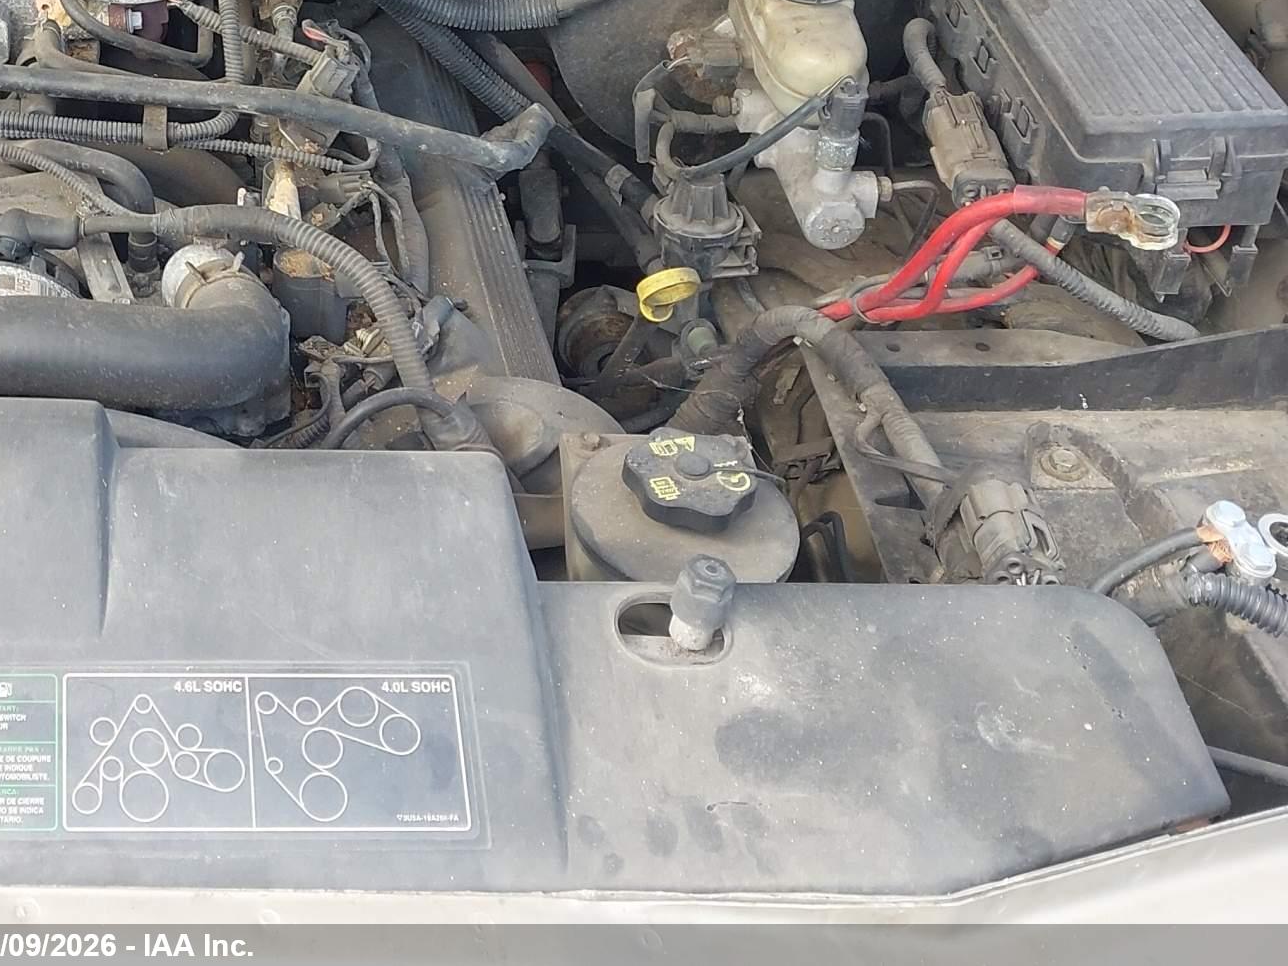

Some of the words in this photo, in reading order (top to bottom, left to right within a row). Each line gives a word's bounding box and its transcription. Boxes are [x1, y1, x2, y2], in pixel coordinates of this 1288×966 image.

[174, 681, 201, 693] 4.6L
[203, 681, 243, 693] SOHC
[381, 681, 409, 693] 4.0L
[411, 681, 451, 693] SOHC
